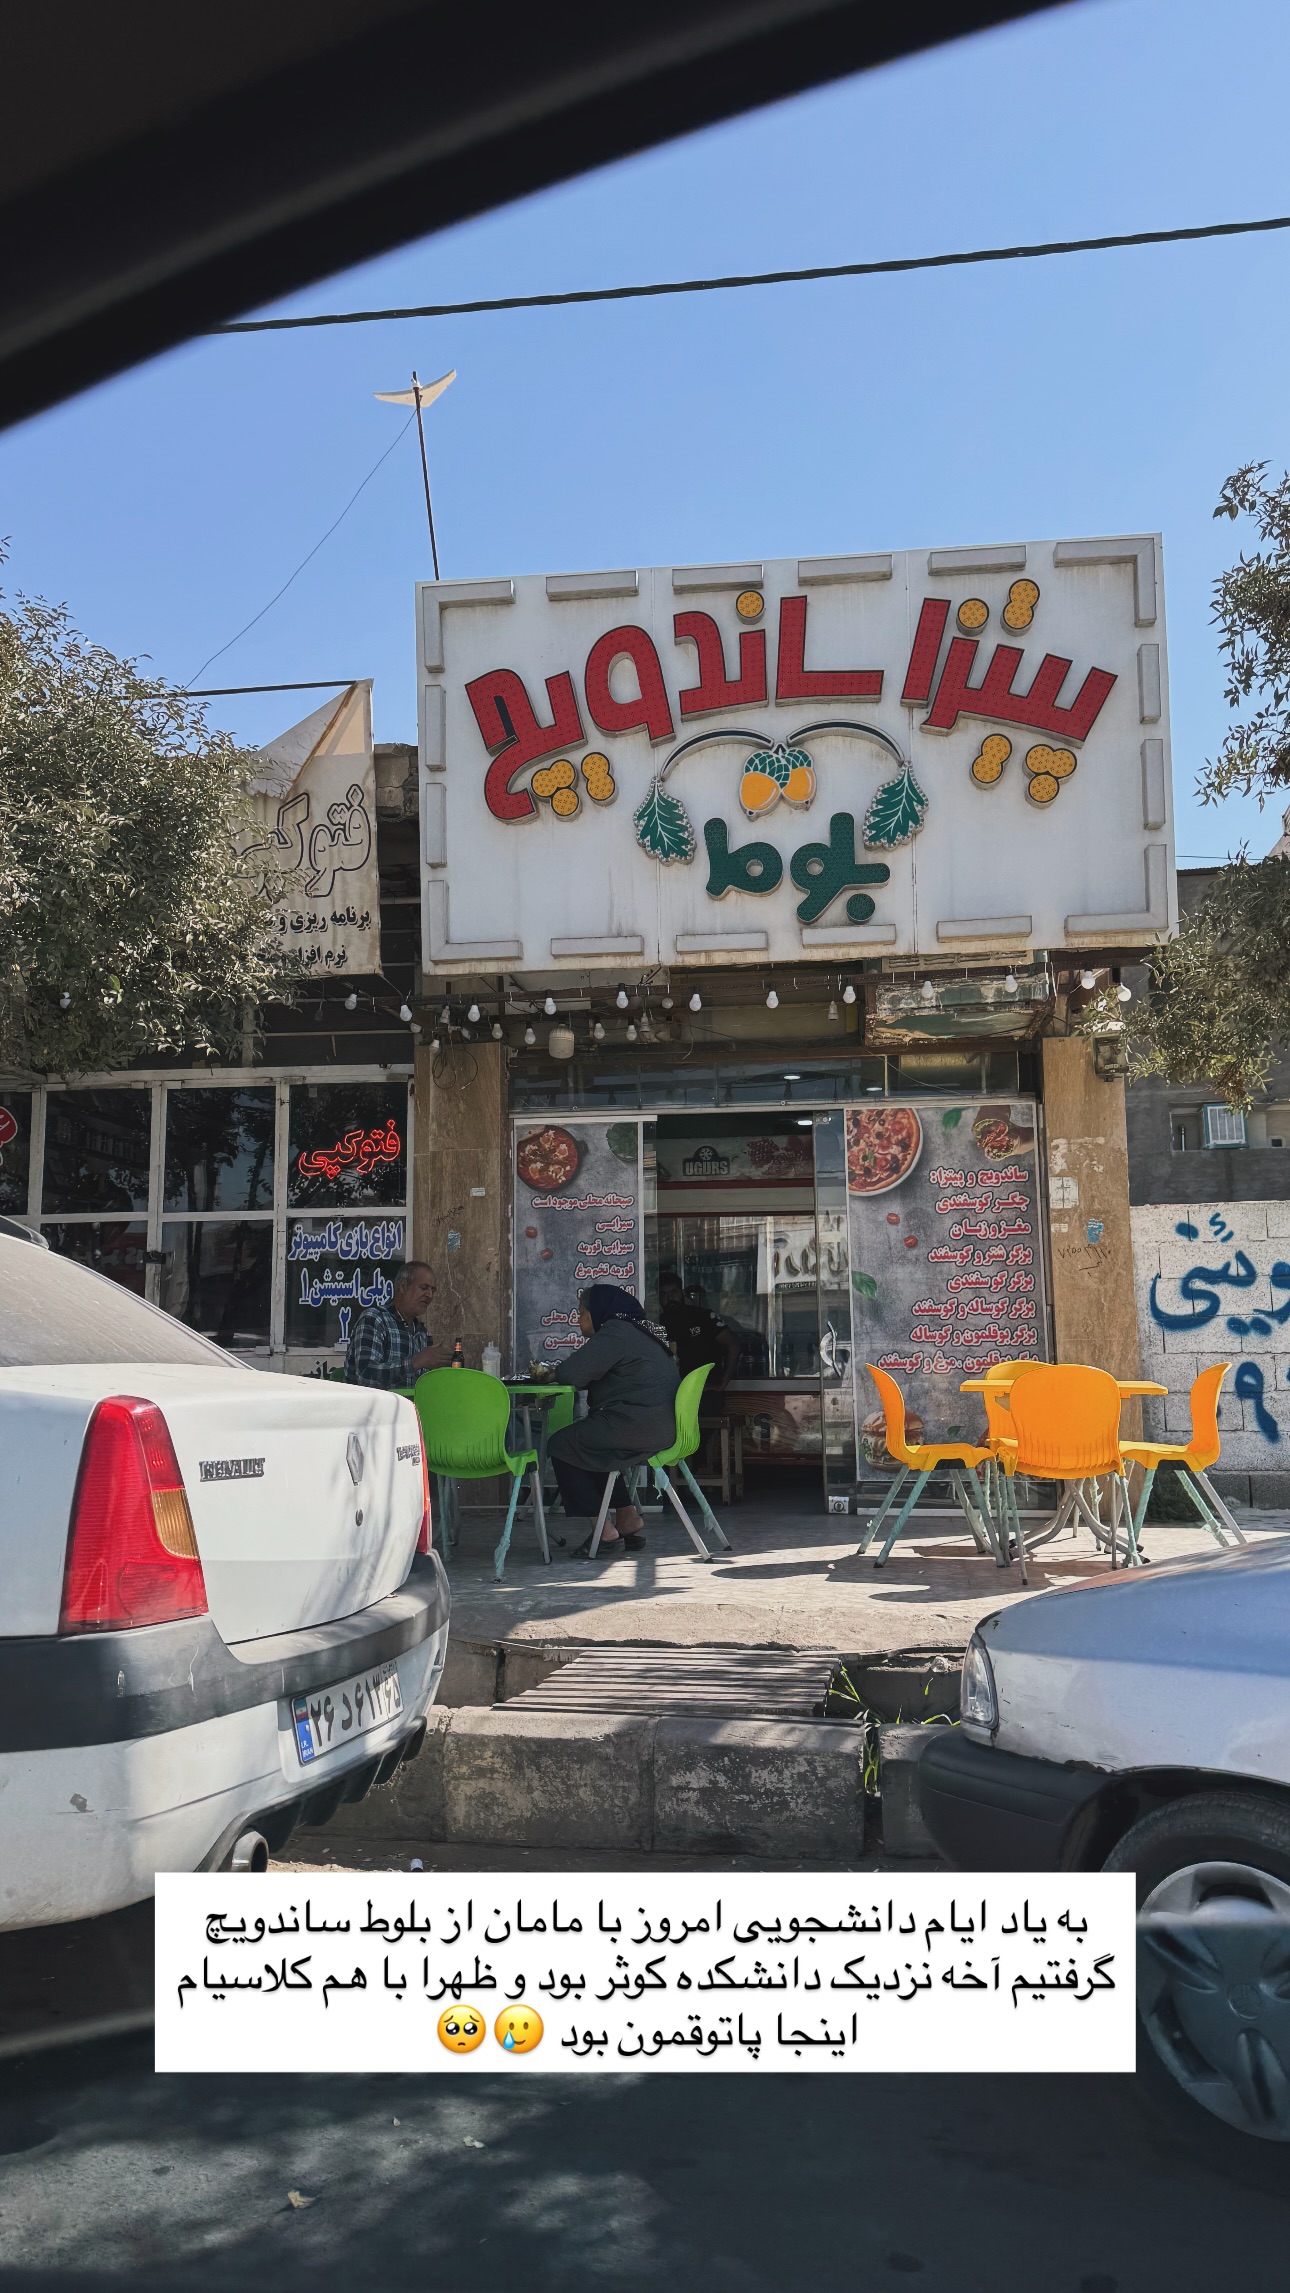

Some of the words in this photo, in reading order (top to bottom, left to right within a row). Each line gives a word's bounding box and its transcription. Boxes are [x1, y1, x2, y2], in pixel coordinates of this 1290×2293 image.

[902, 579, 1118, 808] پیتزا
[466, 590, 885, 824] ساندویچ
[231, 783, 371, 905] فتوک
[704, 812, 890, 924] بلوط
[290, 911, 328, 934] ریزی
[330, 906, 371, 931] برنامه
[325, 945, 348, 968] نرم
[299, 1119, 400, 1179] فتوکپی
[685, 1160, 729, 1176] UGURS
[978, 1165, 1028, 1187] ساندویچ
[966, 1172, 976, 1187] و
[532, 1194, 552, 1207] است
[552, 1197, 579, 1210] موجود
[579, 1193, 604, 1208] محلی
[604, 1192, 634, 1208] صبحانه
[936, 1192, 993, 1213] گوسفندی
[950, 1219, 989, 1239] زبان
[989, 1224, 999, 1238] و
[999, 1218, 1031, 1238] مغز
[288, 1221, 342, 1261] کامپیوتر
[339, 1220, 369, 1260] بازی
[369, 1220, 402, 1260] انواع
[578, 1239, 602, 1255] قورمه
[929, 1245, 974, 1266] گوسفند
[973, 1250, 984, 1265] و
[983, 1244, 1006, 1265] شتر
[1006, 1244, 1033, 1265] برگر
[575, 1262, 593, 1278] مرغ
[592, 1263, 610, 1278] تخم
[610, 1261, 634, 1278] قورمه
[309, 1268, 361, 1307] استیشن
[1007, 1271, 1035, 1292] برگر
[541, 1310, 568, 1325] محلی
[913, 1297, 957, 1319] گوسفند
[957, 1303, 968, 1319] و
[968, 1297, 1009, 1319] گوساله
[1009, 1297, 1036, 1319] برگر
[910, 1325, 953, 1346] گوساله
[953, 1329, 964, 1345] و
[963, 1323, 1011, 1345] بوقلمون
[1011, 1323, 1038, 1345] برگر
[878, 1351, 923, 1373] گوسفند
[923, 1357, 932, 1373] و
[932, 1350, 957, 1373] مرغ
